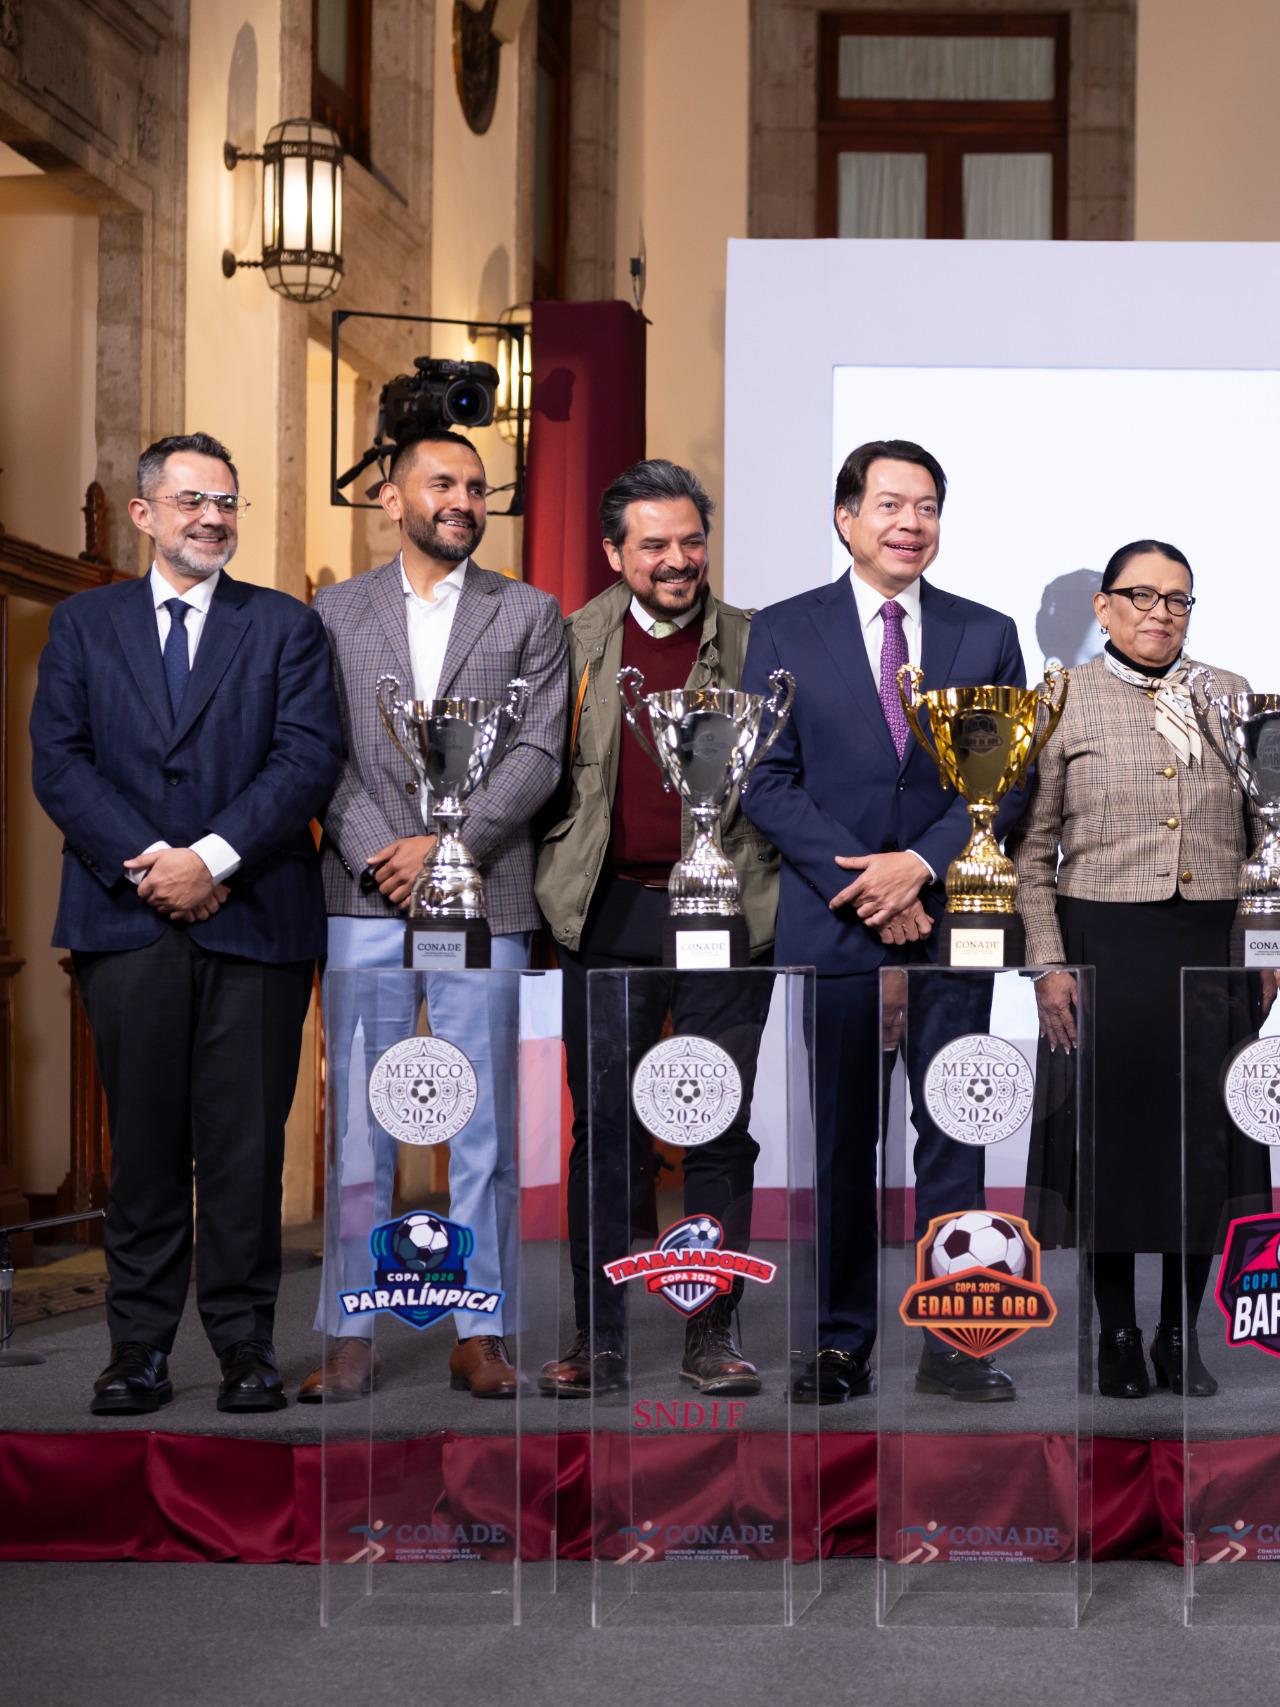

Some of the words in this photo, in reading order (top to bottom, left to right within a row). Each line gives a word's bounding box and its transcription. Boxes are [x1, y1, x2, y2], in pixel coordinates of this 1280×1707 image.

[417, 943, 462, 951] CONADE
[955, 941, 999, 949] CONADE
[385, 1063, 463, 1078] MEXICO
[649, 1063, 727, 1078] MEXICO
[941, 1062, 1020, 1077] MEXICO
[400, 1108, 447, 1124] 2026
[665, 1108, 711, 1124] 2026
[957, 1107, 1003, 1123] 2026
[608, 1251, 772, 1280] TRABAJADORES
[387, 1273, 420, 1282] COPA
[424, 1273, 455, 1281] 2026
[661, 1273, 688, 1284] COPA
[691, 1272, 717, 1284] 2026
[1243, 1272, 1278, 1291] COPA
[955, 1282, 976, 1293] COPA
[978, 1282, 1001, 1293] 2026
[342, 1283, 500, 1313] PARALÍMPICA
[917, 1295, 965, 1317] EDAD
[972, 1295, 994, 1317] DE
[1002, 1295, 1038, 1317] ORO
[634, 1399, 746, 1429] SNDIF
[396, 1523, 505, 1544] CONADE
[664, 1525, 774, 1544] CONADE
[949, 1525, 1059, 1546] CONADE
